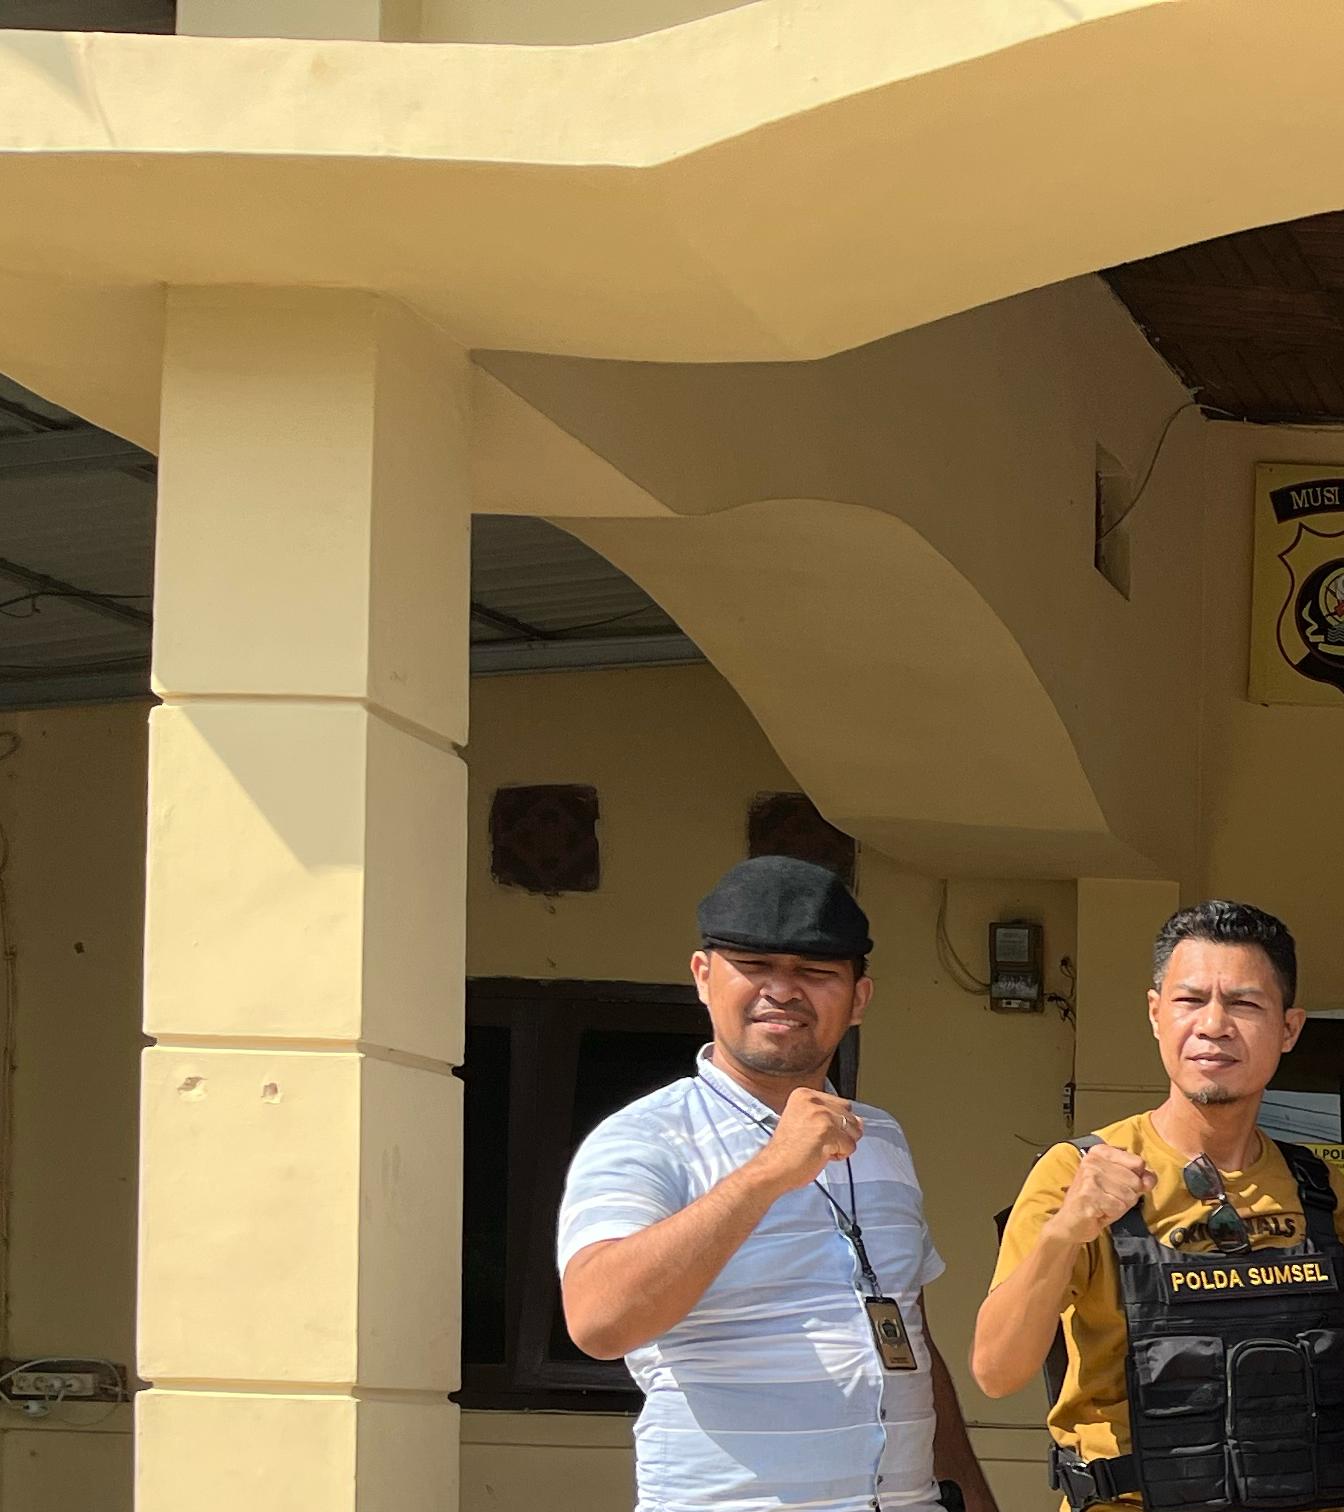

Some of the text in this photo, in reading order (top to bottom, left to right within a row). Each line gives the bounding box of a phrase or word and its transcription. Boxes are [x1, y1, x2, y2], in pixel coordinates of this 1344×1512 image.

[1290, 486, 1342, 512] MUSI
[1170, 1263, 1330, 1293] POLDA SUMSEL
